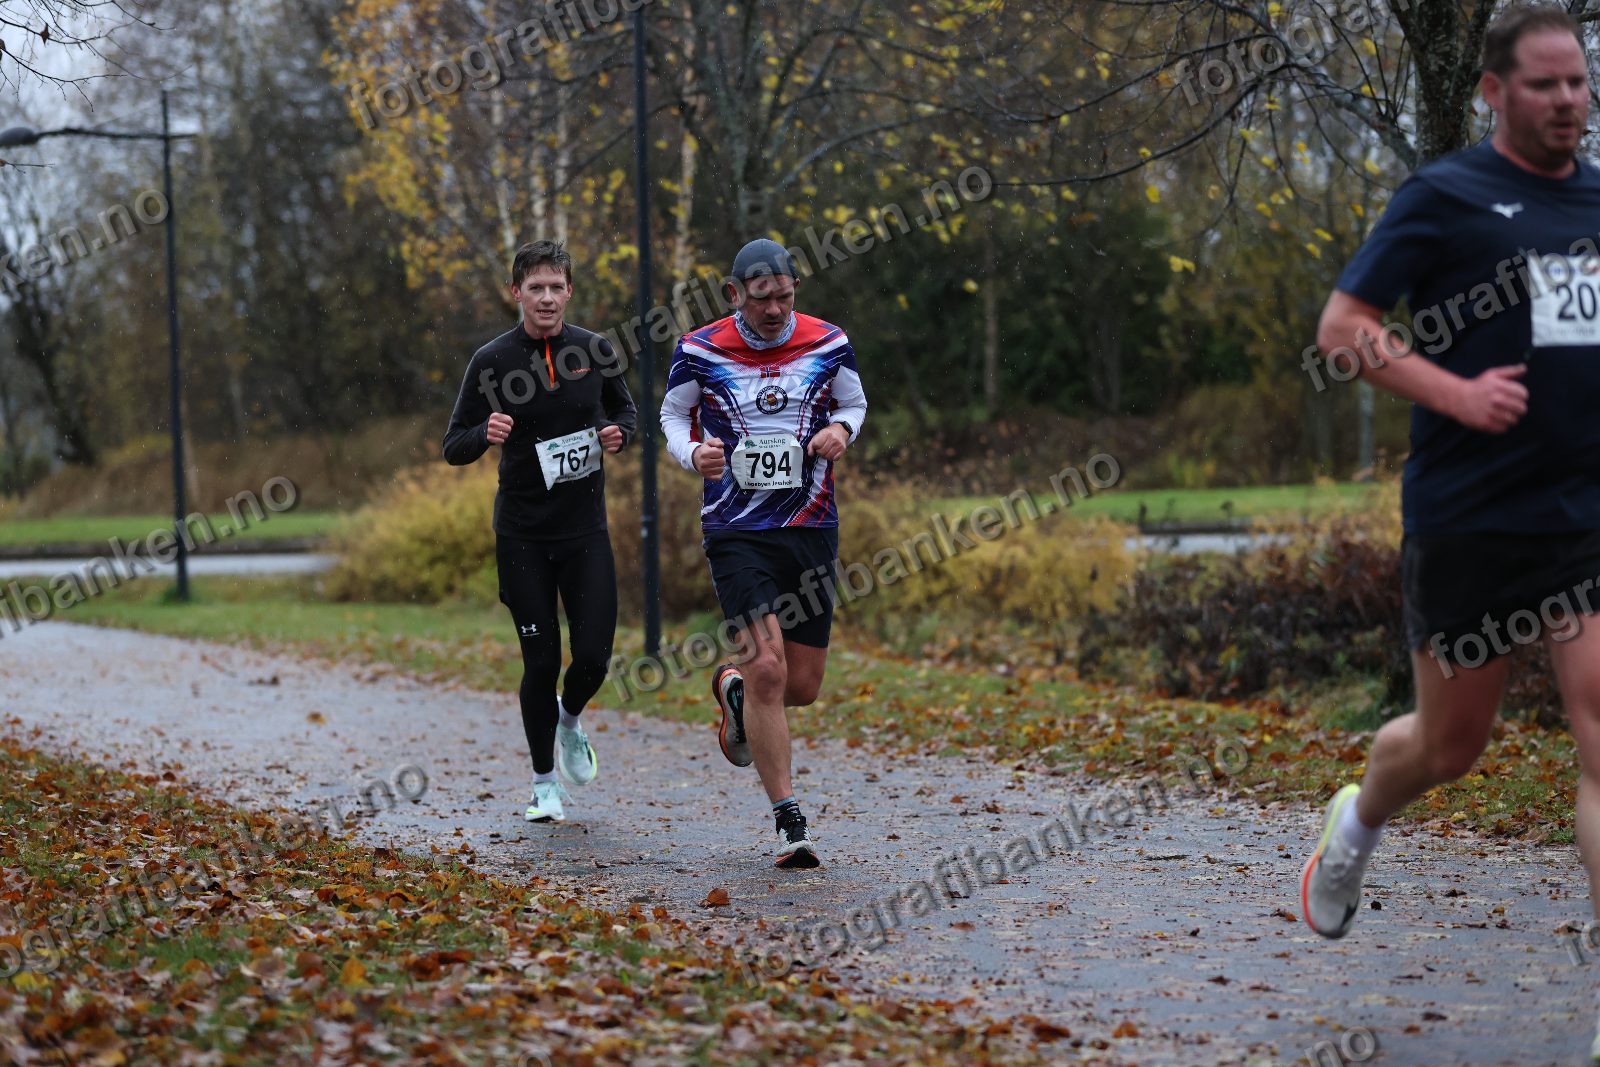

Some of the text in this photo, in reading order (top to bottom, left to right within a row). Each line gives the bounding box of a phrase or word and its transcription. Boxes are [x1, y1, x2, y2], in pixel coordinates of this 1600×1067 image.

[1556, 283, 1600, 321] 20
[552, 445, 590, 476] 767
[746, 450, 791, 478] 794
